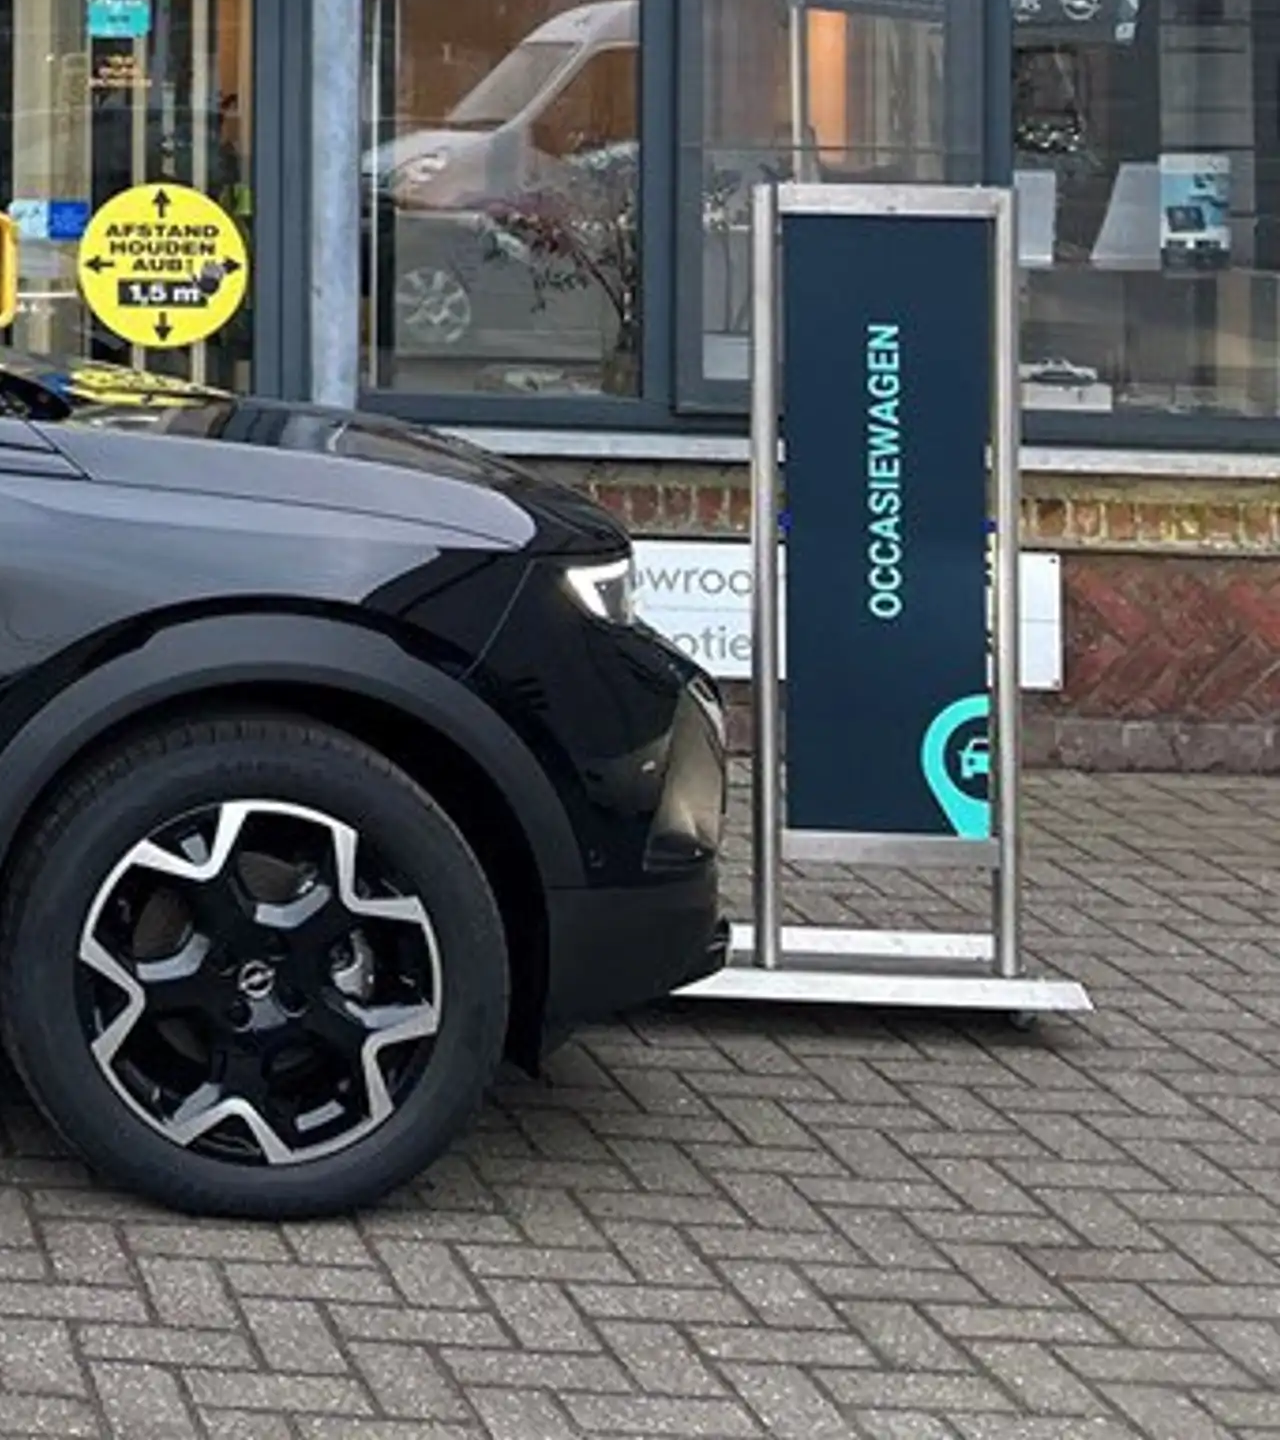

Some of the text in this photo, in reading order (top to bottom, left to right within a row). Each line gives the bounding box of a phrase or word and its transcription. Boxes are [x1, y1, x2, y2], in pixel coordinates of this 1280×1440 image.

[105, 222, 220, 239] AFSTAND
[109, 240, 216, 256] HOUDEN
[129, 283, 200, 305] 1,5 m
[866, 324, 903, 619] OCCASIEWAGEN
